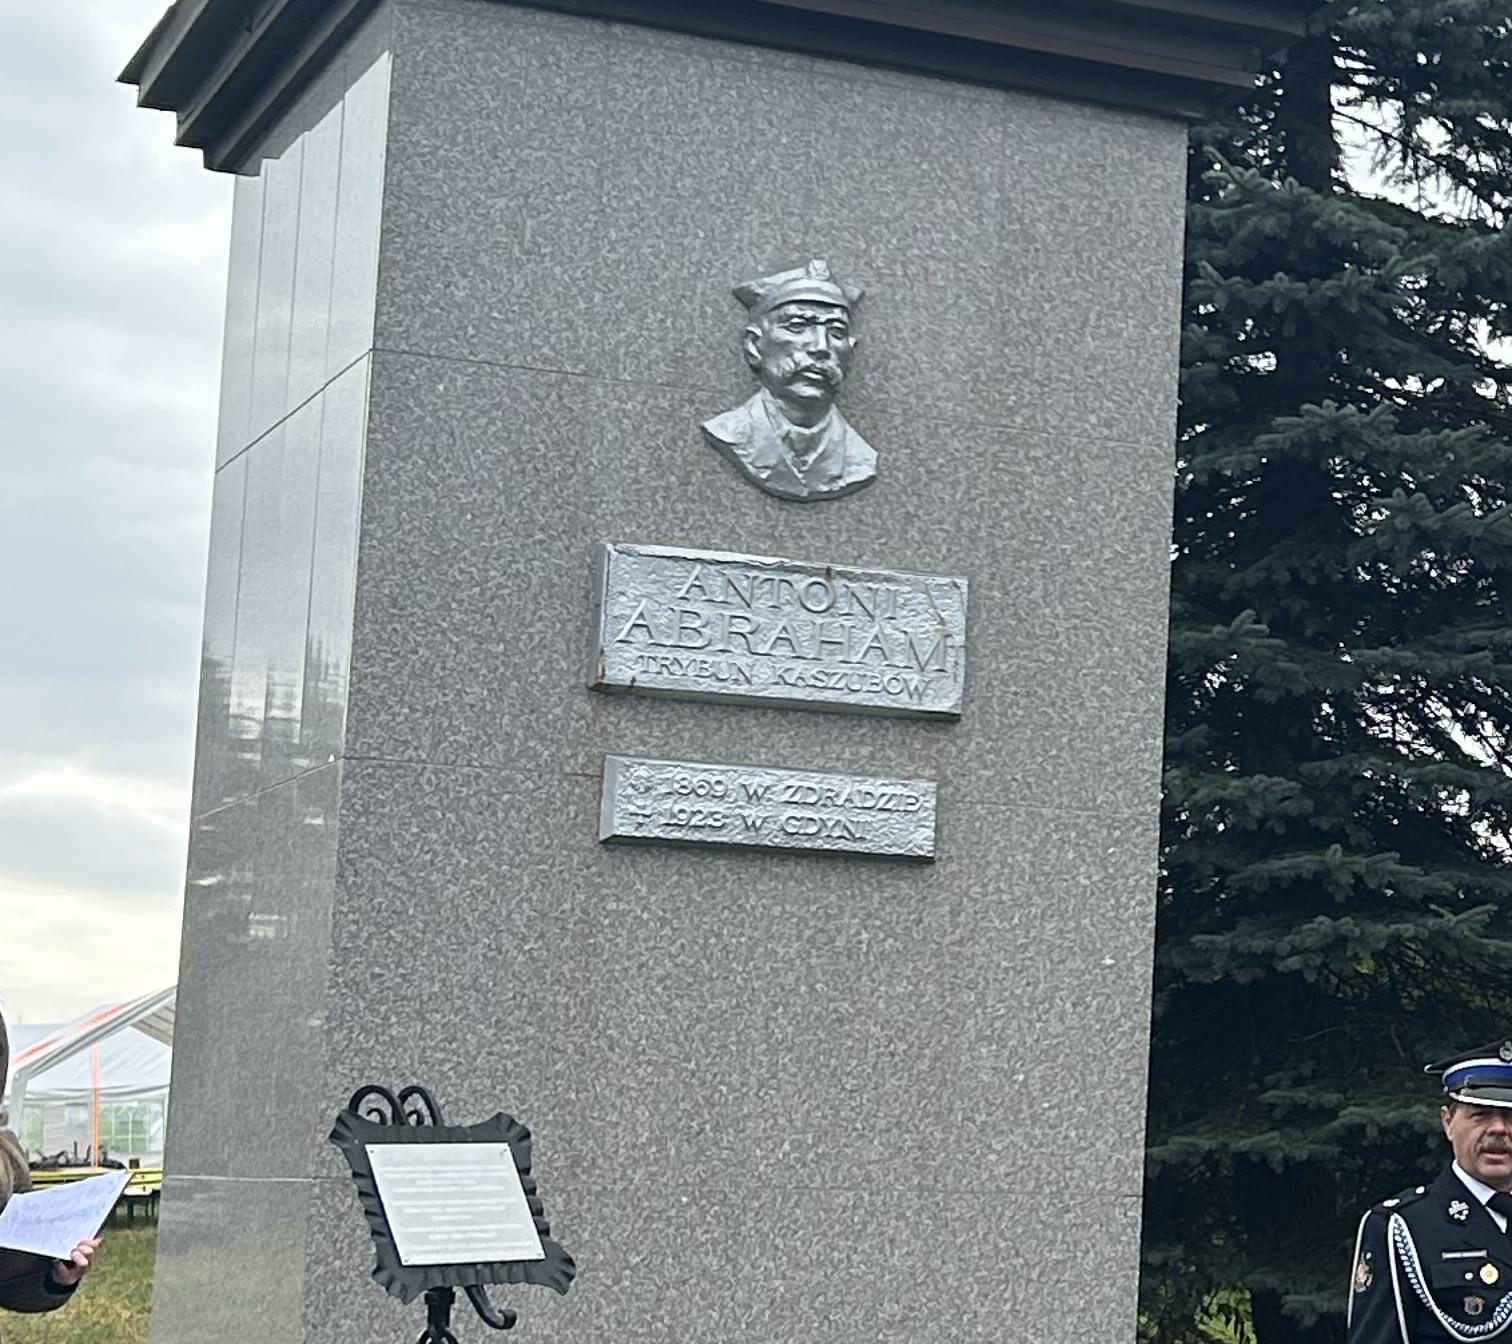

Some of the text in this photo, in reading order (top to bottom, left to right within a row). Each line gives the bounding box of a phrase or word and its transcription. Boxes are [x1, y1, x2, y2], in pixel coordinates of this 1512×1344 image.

[676, 564, 900, 621] ANTONI
[614, 598, 948, 673] ABRAHAM
[637, 655, 753, 685] TRYBUN
[738, 811, 771, 833] W
